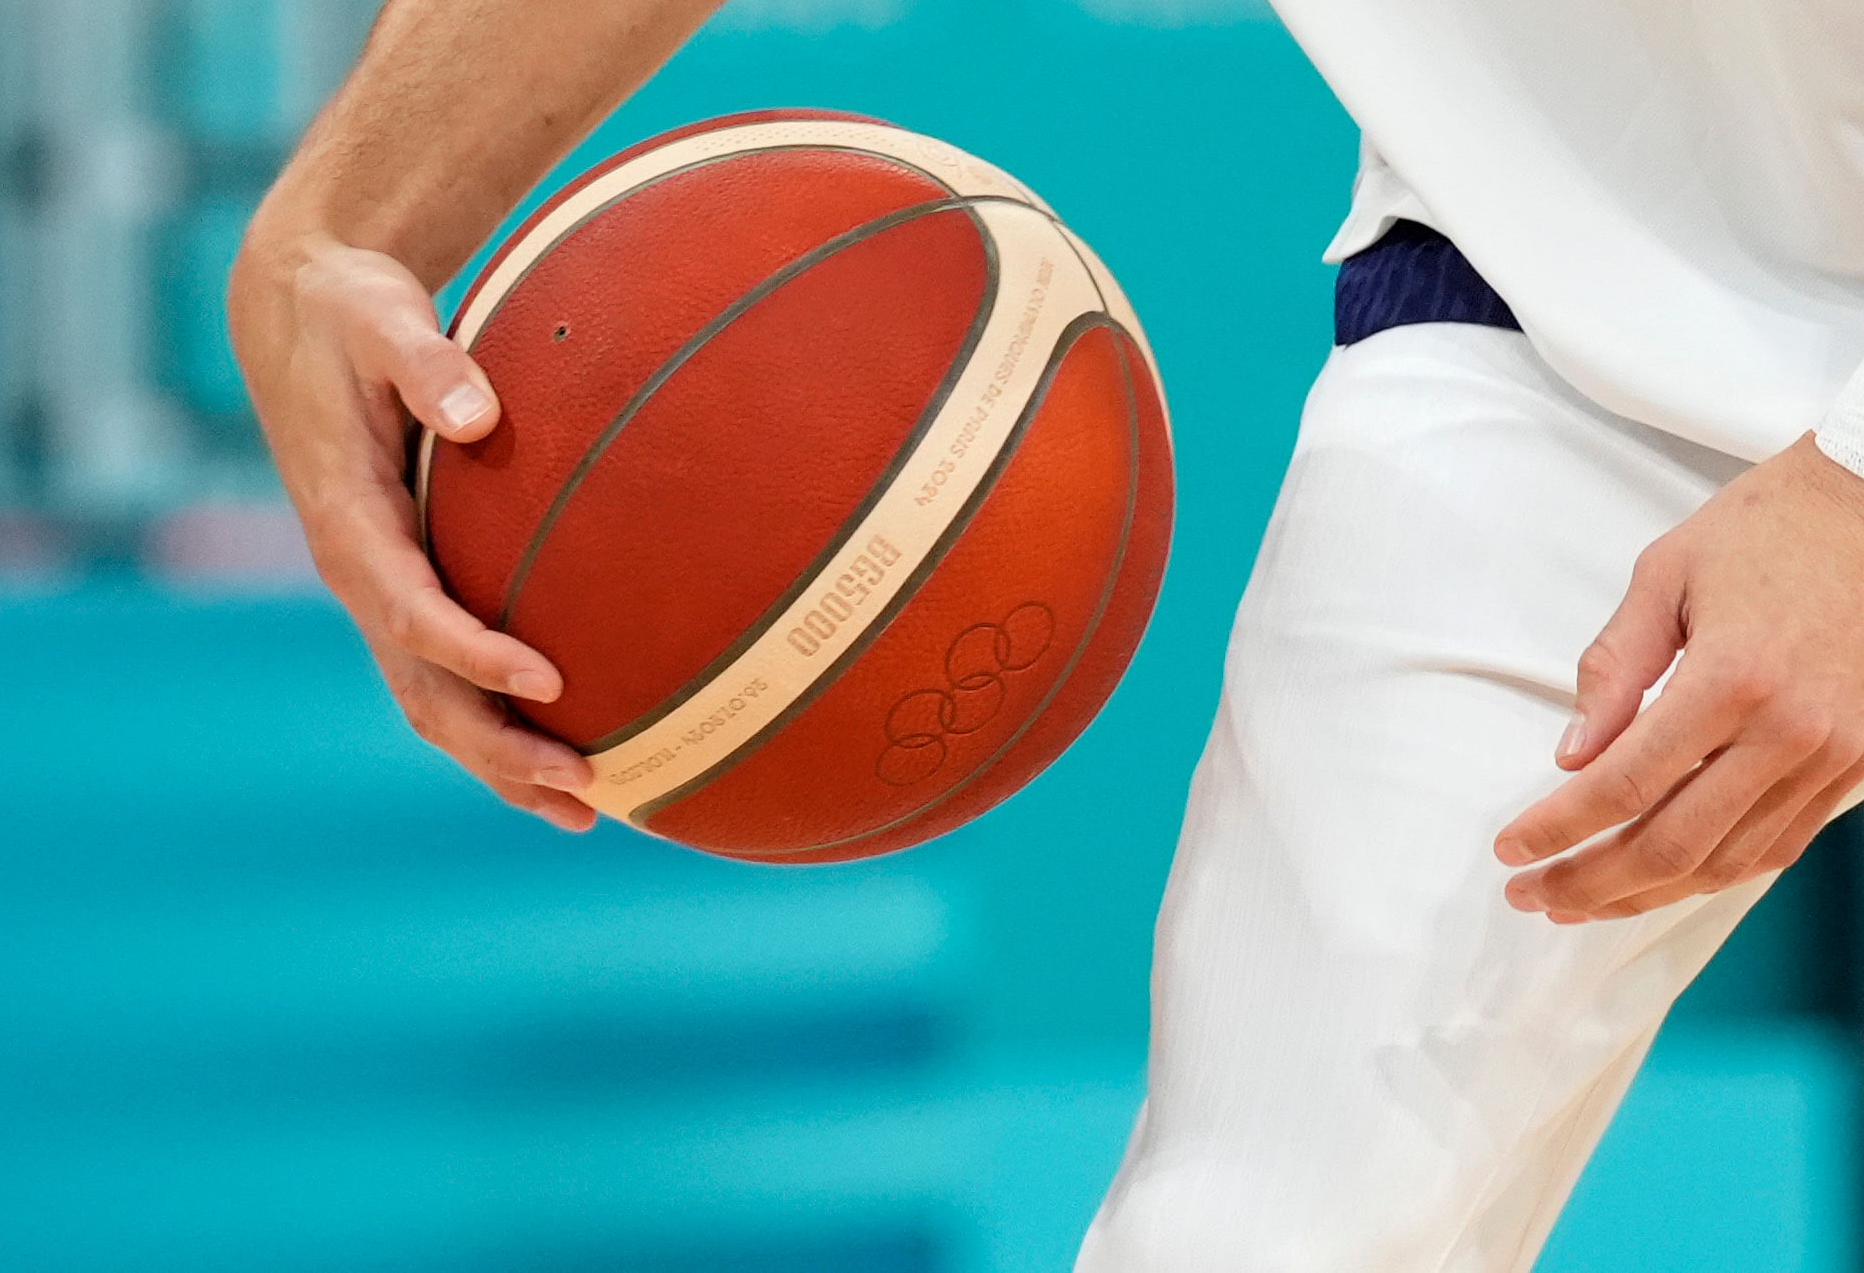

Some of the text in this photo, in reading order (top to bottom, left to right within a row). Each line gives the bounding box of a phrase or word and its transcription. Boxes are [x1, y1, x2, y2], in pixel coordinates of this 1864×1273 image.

[980, 383, 1003, 409] DE
[949, 405, 989, 460] PARIS
[914, 460, 955, 507] 2024
[786, 533, 903, 657] BG5000
